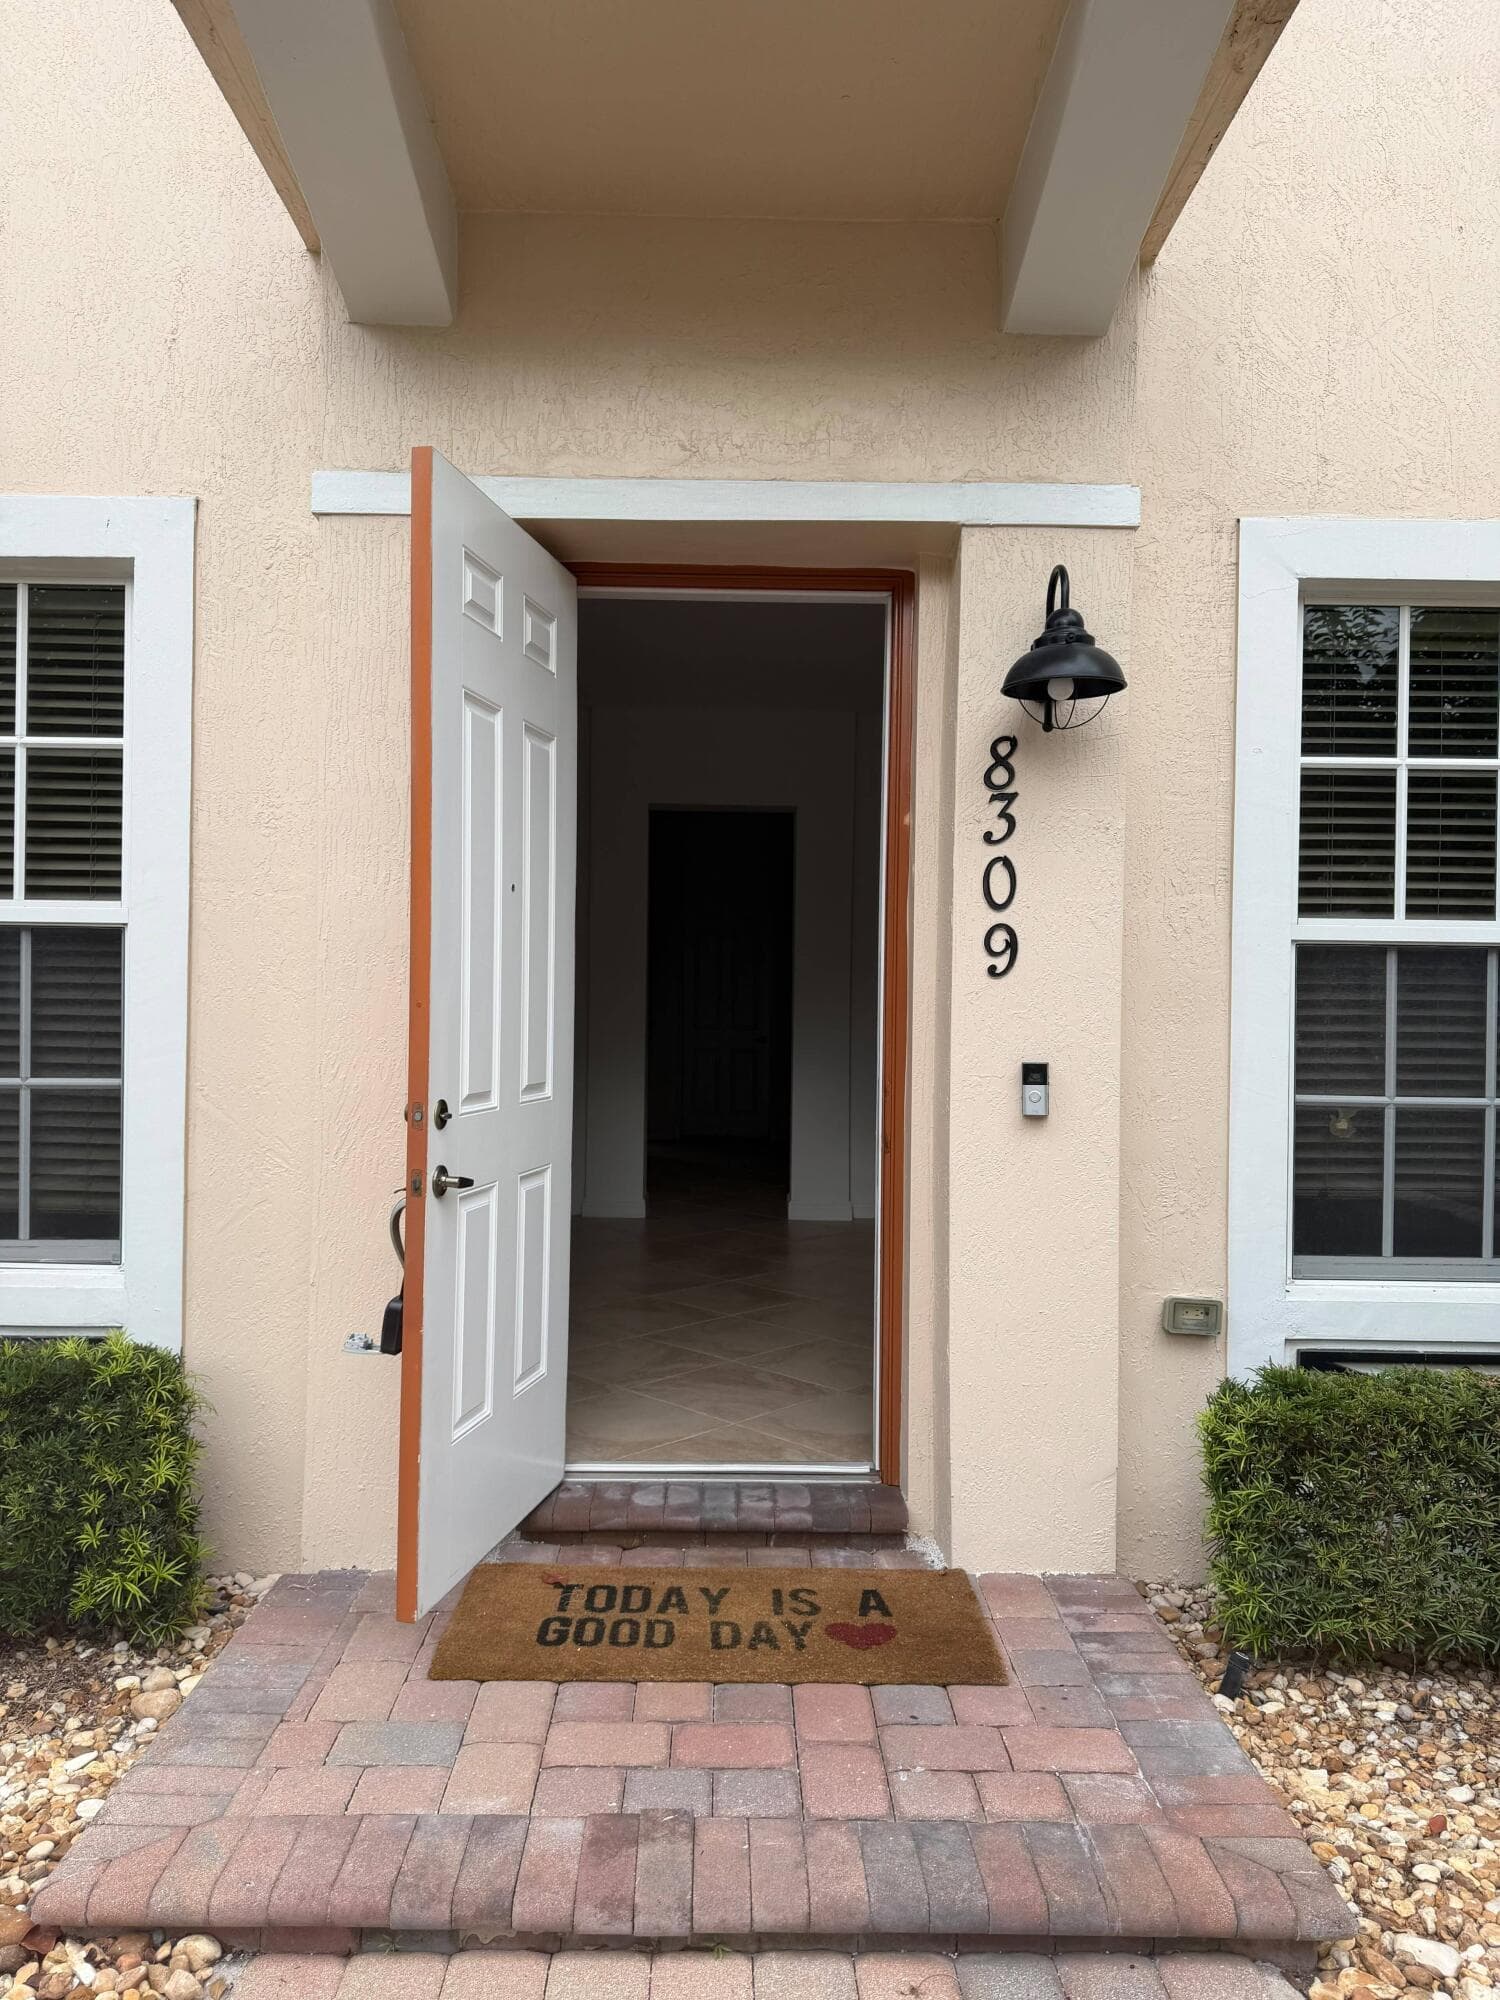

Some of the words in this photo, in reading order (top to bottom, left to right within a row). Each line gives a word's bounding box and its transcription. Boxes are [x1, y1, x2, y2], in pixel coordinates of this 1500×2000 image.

[982, 735, 1018, 979] 8309
[554, 1583, 731, 1615] TODAY
[771, 1588, 822, 1616] IS
[859, 1589, 894, 1617] A
[536, 1616, 676, 1647] GOOD
[710, 1621, 813, 1650] DAY
